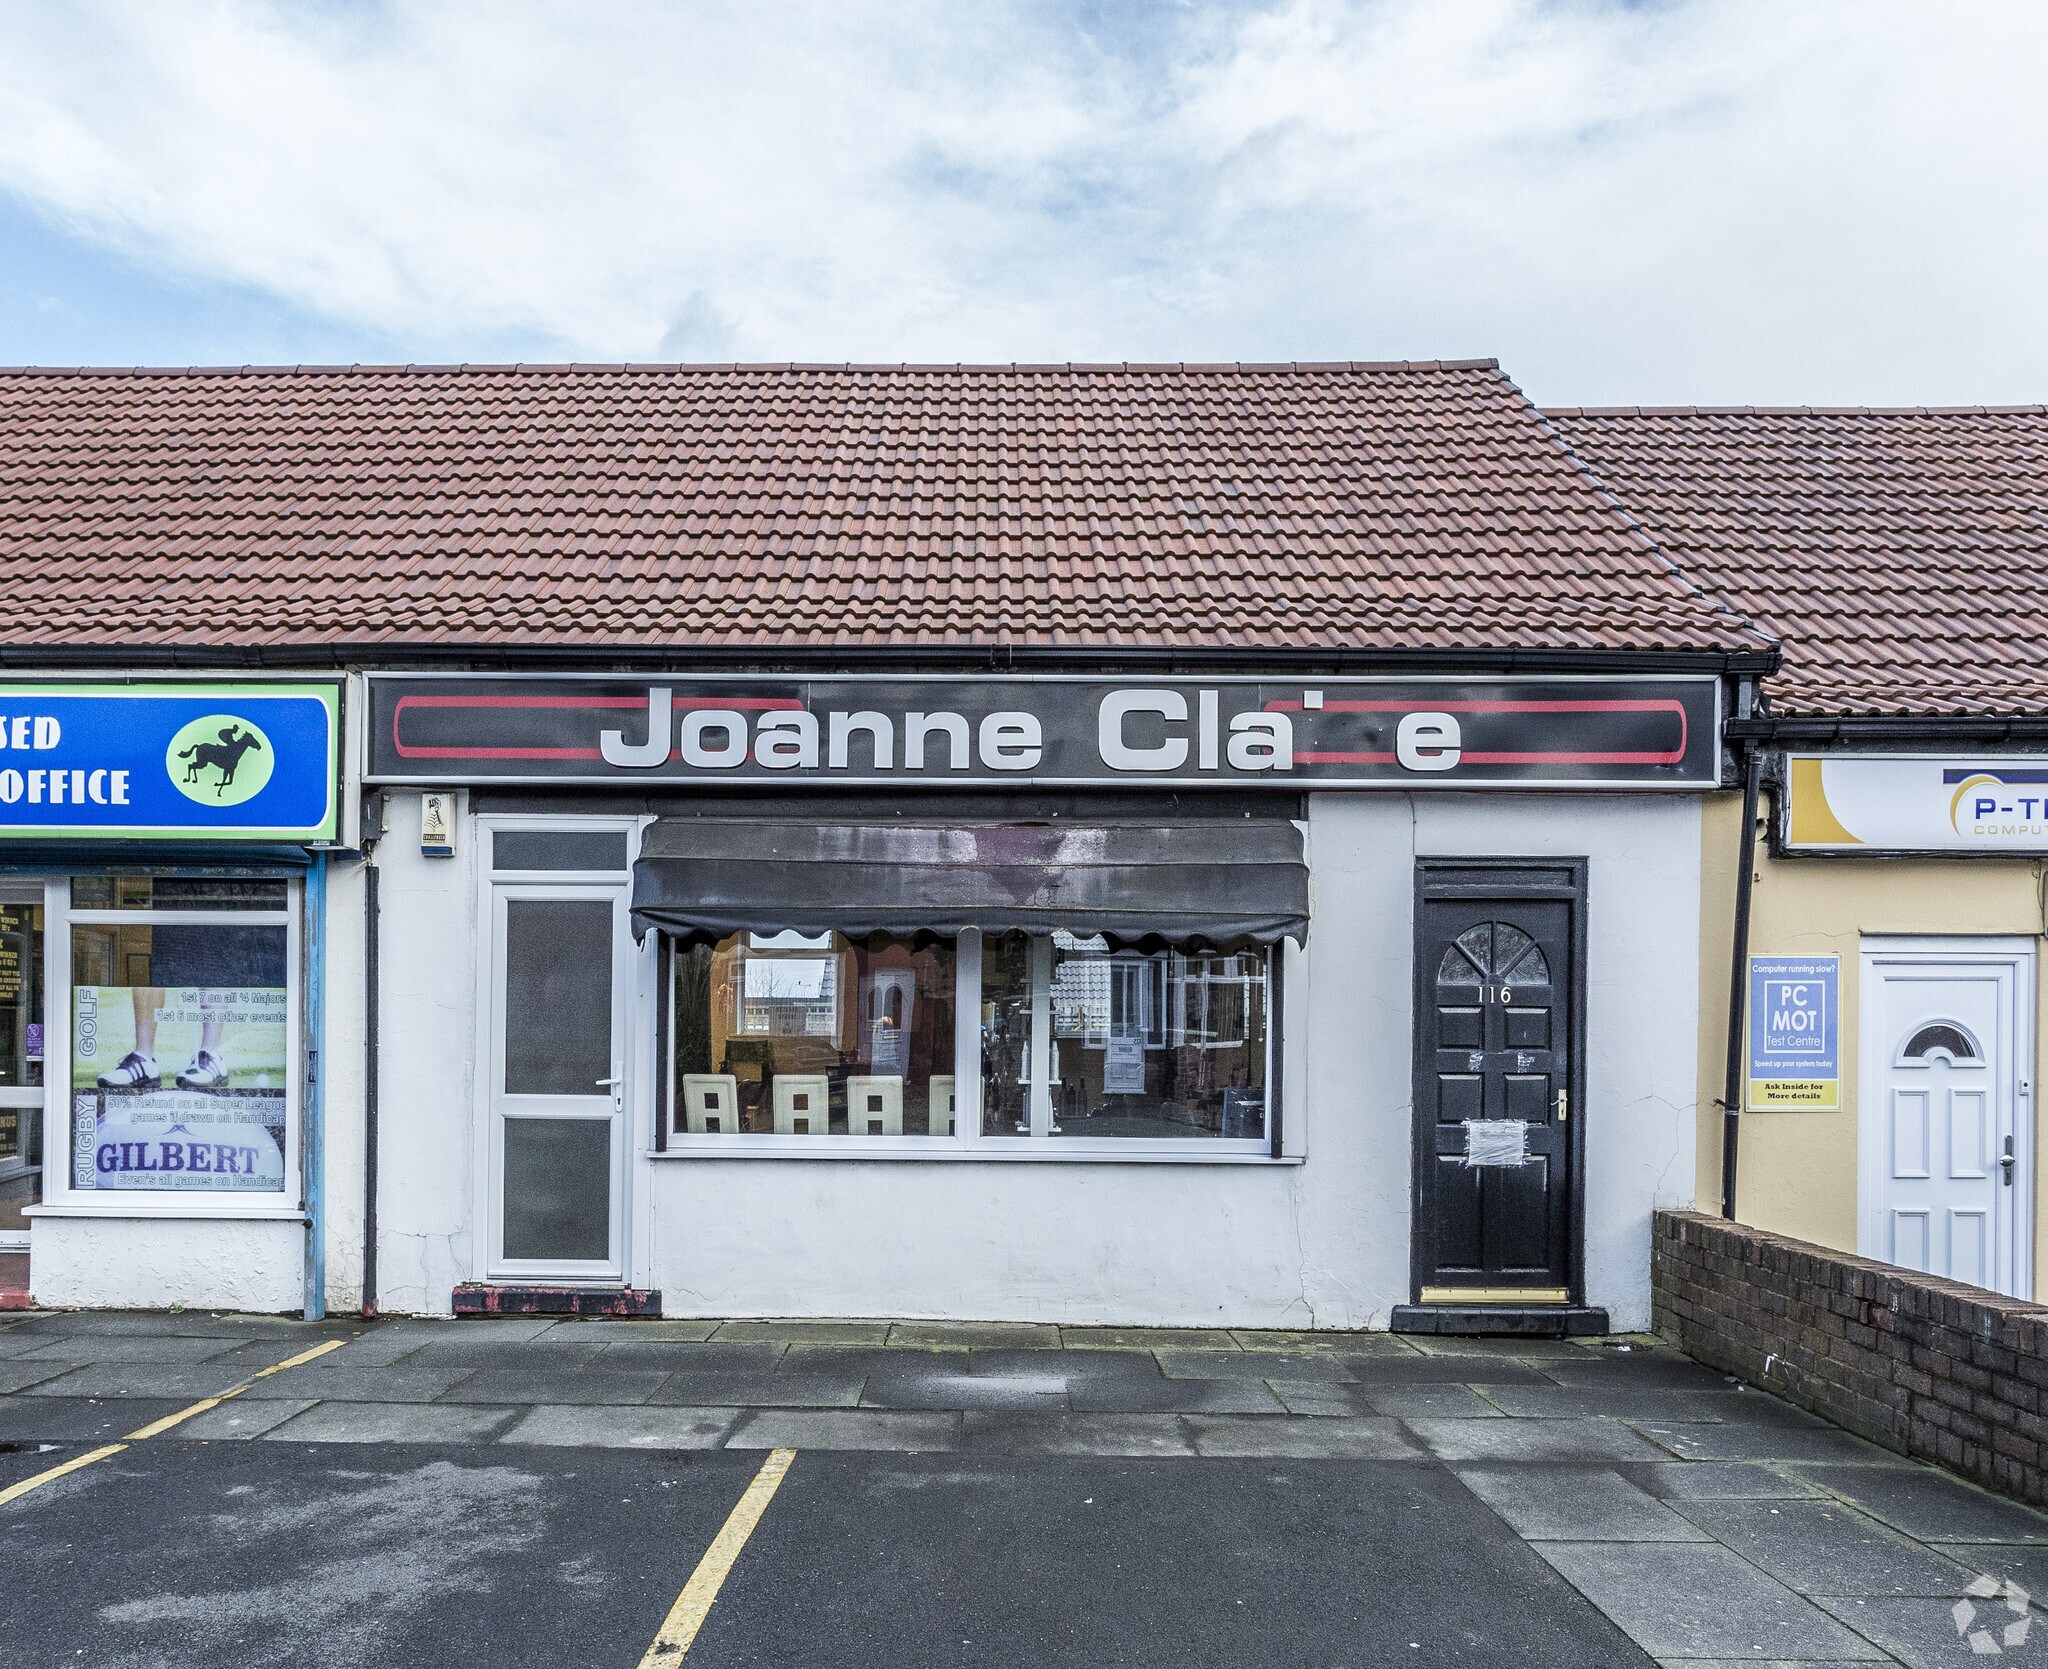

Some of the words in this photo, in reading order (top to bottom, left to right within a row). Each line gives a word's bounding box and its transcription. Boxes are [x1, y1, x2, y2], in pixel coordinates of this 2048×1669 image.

[600, 687, 1042, 770] Joanne
[0, 768, 130, 804] OFFICE
[1975, 798, 2048, 820] P-T
[1974, 825, 2048, 835] COMPU
[1752, 964, 1787, 974] Computer
[1788, 964, 1814, 974] running
[1816, 964, 1836, 973] slow?
[181, 992, 197, 1002] 1st
[199, 992, 206, 1002] 7
[208, 994, 222, 1003] on
[224, 992, 237, 1003] all
[251, 992, 287, 1006] Majors
[1478, 986, 1511, 1003] 116
[1781, 985, 1808, 1006] PC
[79, 989, 98, 1056] GOLF
[157, 1010, 175, 1021] 1st
[177, 1010, 184, 1021] 6
[187, 1011, 215, 1021] most
[217, 1010, 248, 1022] other
[250, 1012, 287, 1023] events
[1772, 1010, 1817, 1031] MOT
[1767, 1035, 1785, 1046] Test
[1787, 1035, 1820, 1046] Centre
[1754, 1060, 1773, 1068] Speed
[1796, 1060, 1815, 1068] system
[1816, 1060, 1833, 1068] today
[109, 1096, 132, 1108] 50%
[134, 1097, 175, 1109] Refund
[178, 1098, 191, 1109] on
[194, 1097, 207, 1109] all
[210, 1097, 243, 1111] Super
[245, 1098, 286, 1111] League
[130, 1112, 167, 1124] games
[170, 1111, 179, 1122] if
[181, 1112, 214, 1123] drawn
[217, 1112, 231, 1123] on
[233, 1112, 286, 1125] Handicap
[77, 1098, 95, 1187] RUGBY
[96, 1142, 259, 1174] GILBERT
[117, 1173, 155, 1186] Even's
[158, 1174, 172, 1186] all
[174, 1175, 211, 1188] games
[215, 1175, 230, 1187] on
[232, 1175, 285, 1190] Handicap
